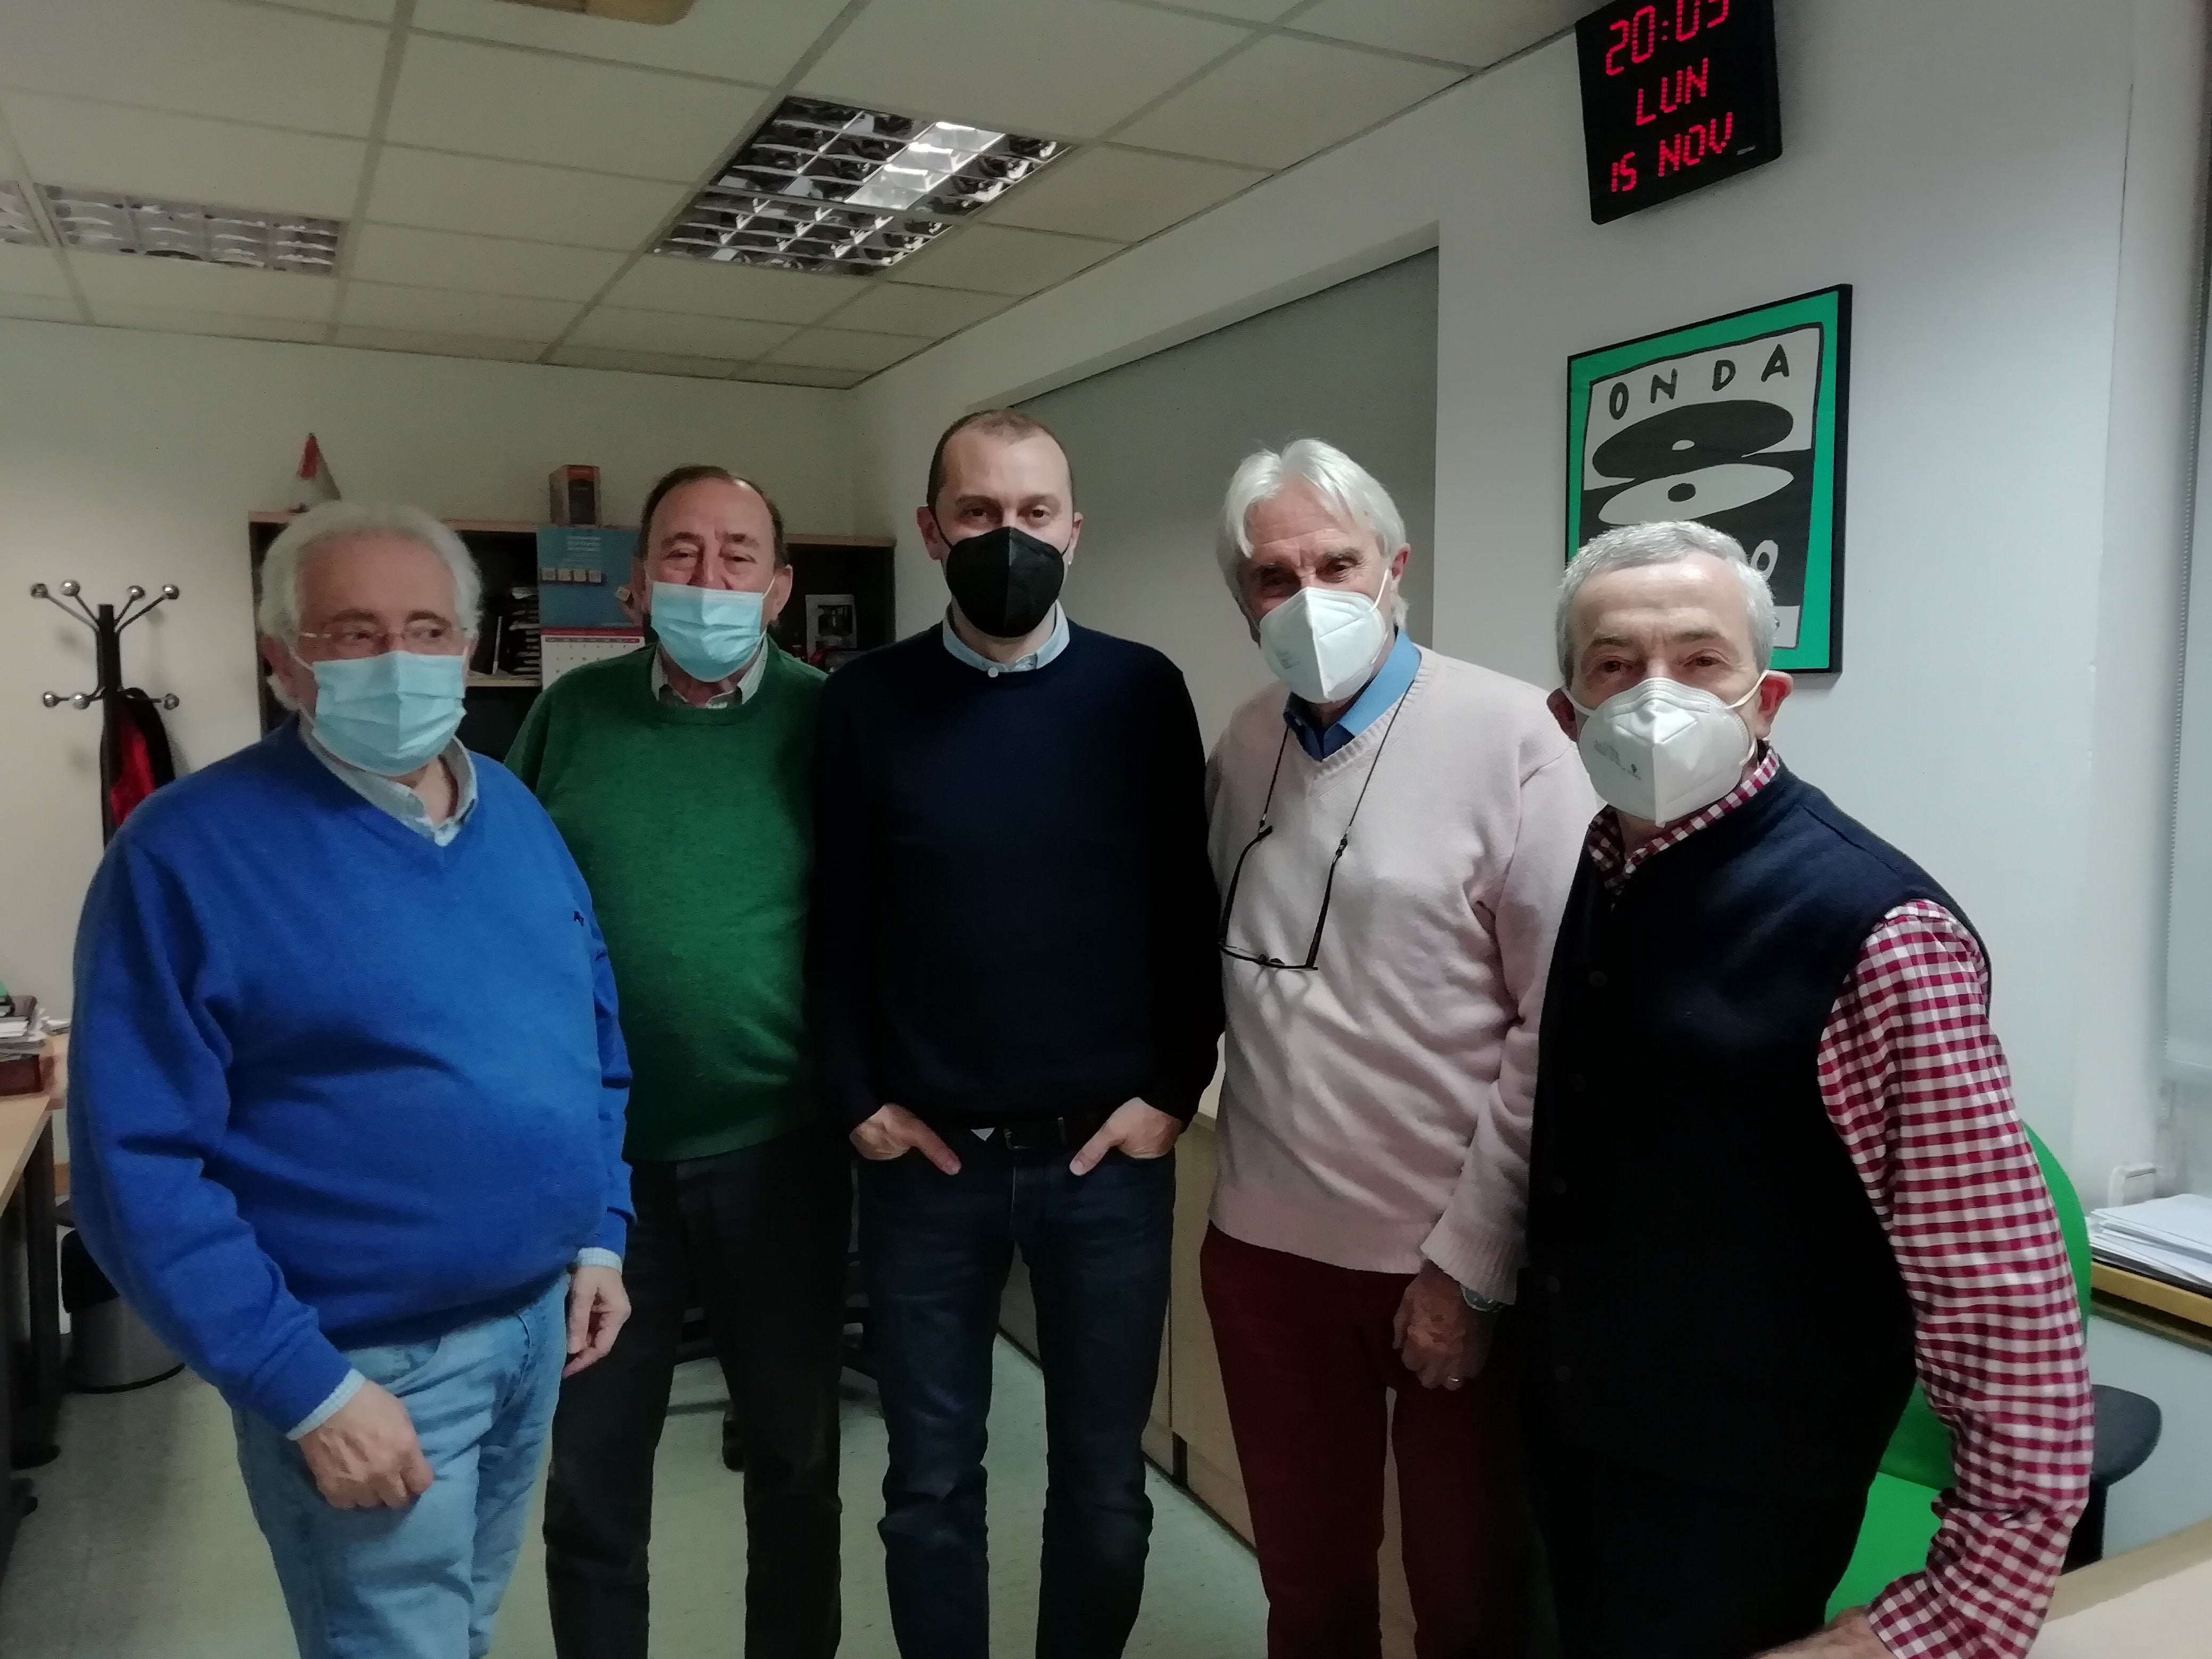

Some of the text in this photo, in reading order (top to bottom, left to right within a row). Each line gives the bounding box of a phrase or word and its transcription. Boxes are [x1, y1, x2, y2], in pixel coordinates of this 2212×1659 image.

[1636, 58, 1708, 125] LUN
[1611, 112, 1733, 192] 15 NOV
[1610, 344, 1789, 420] ONDA
